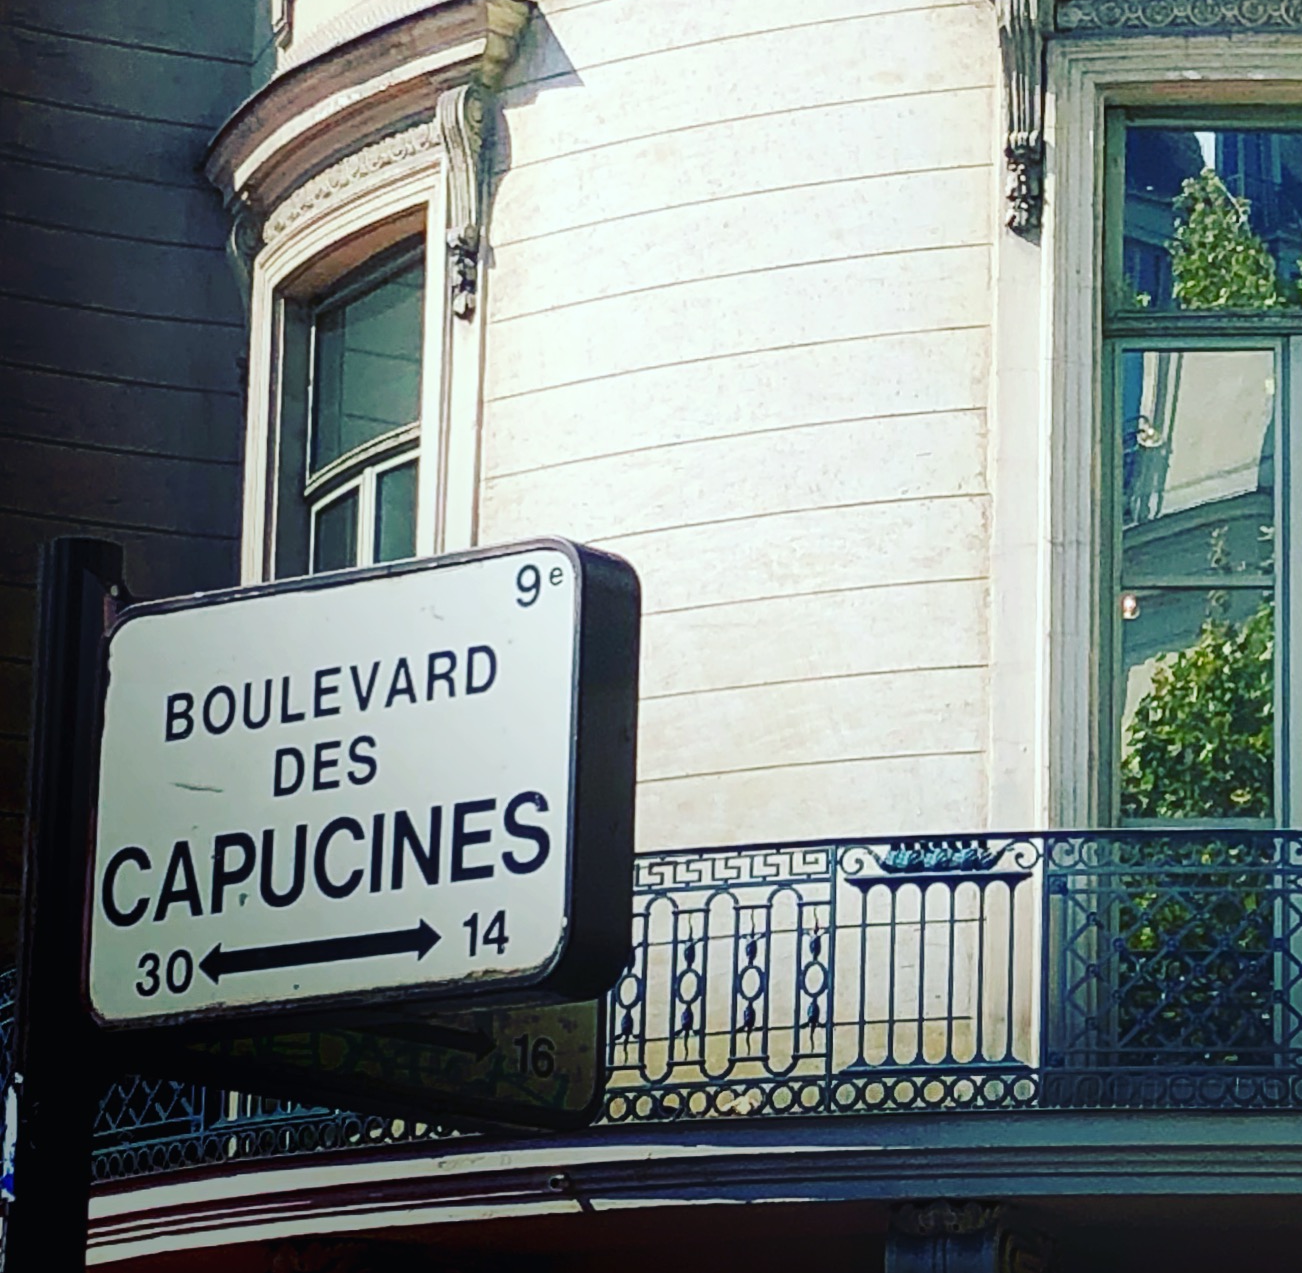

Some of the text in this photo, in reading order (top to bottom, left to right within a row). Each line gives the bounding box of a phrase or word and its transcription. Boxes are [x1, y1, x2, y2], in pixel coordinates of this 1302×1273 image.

[165, 644, 498, 741] BOULEVARD
[273, 736, 378, 798] DES
[102, 791, 551, 927] CAPUCINES
[135, 911, 510, 997] 30 14
[513, 1035, 556, 1078] 16
